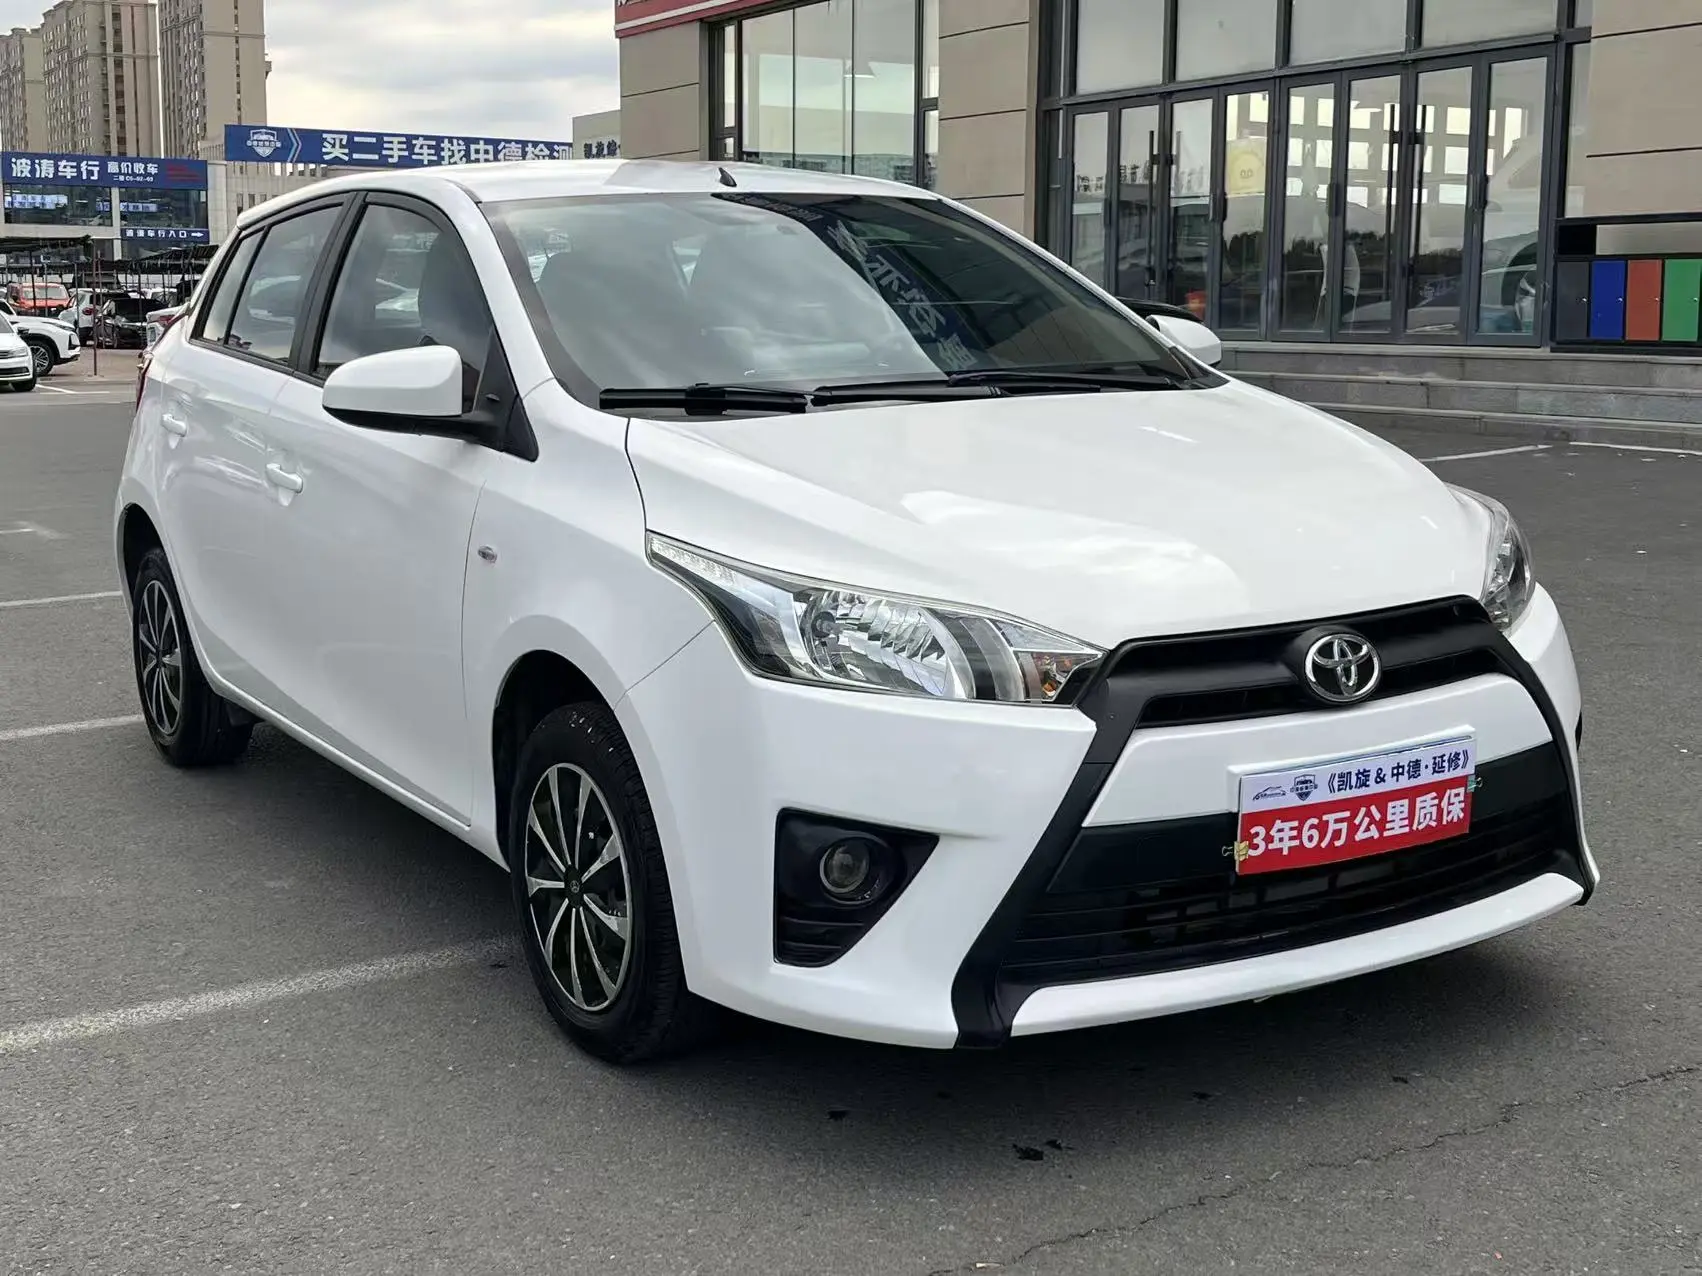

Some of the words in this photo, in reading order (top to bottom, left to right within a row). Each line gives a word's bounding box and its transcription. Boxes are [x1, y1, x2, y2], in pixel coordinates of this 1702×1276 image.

[322, 133, 572, 164] 买二手车找中德检测
[107, 161, 159, 175] 高价收车
[1248, 787, 1465, 857] 3年6万公里质保
